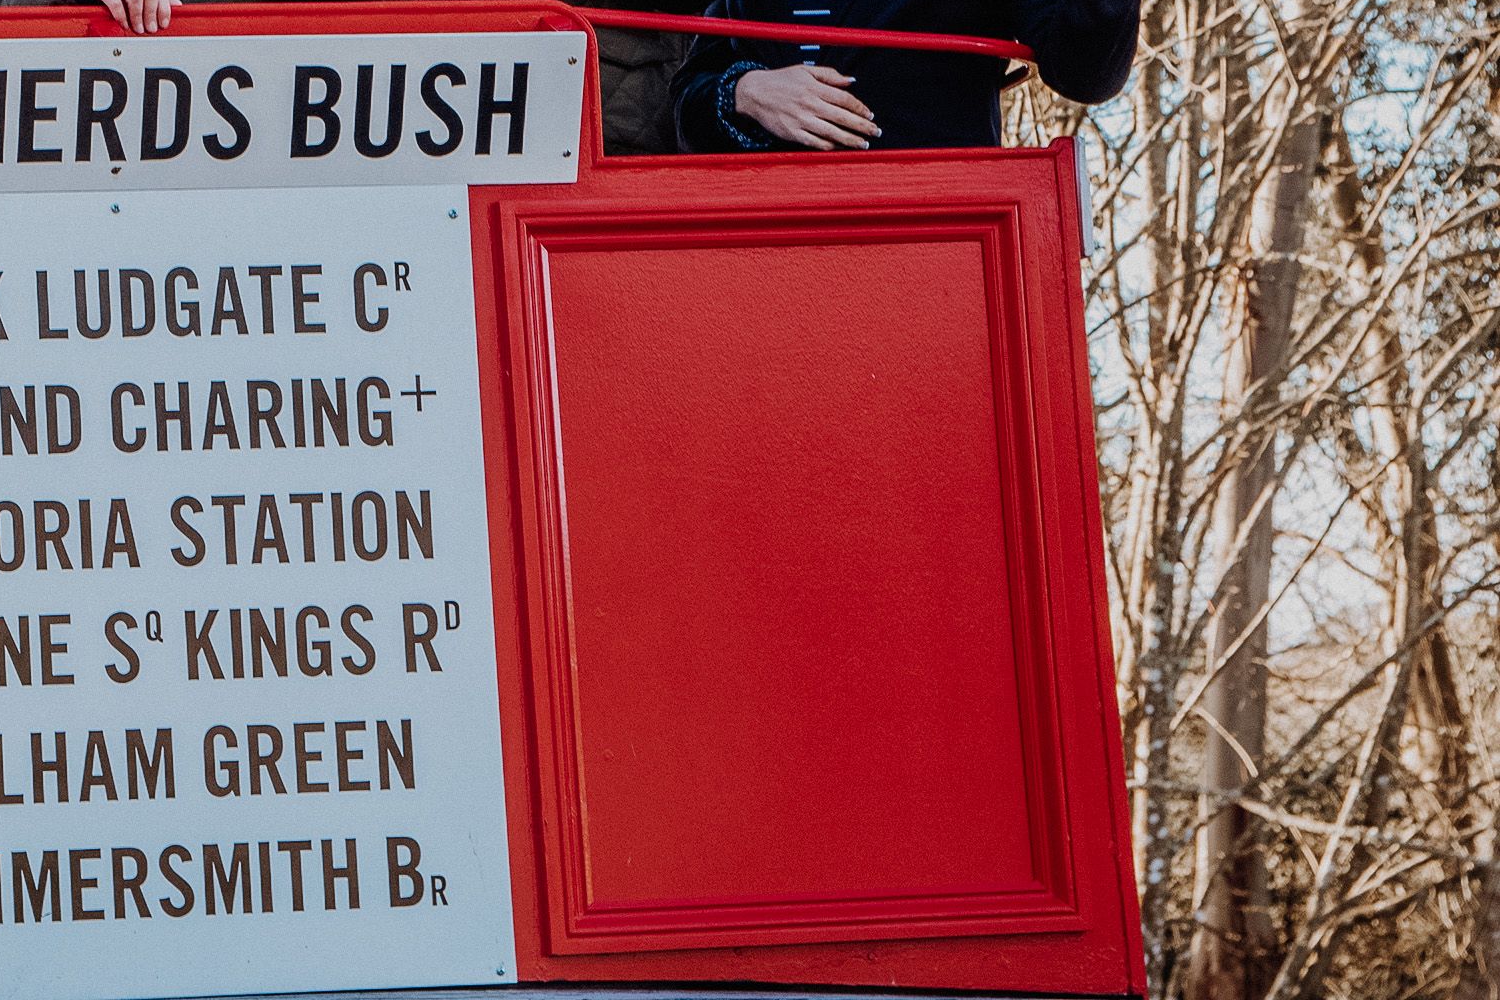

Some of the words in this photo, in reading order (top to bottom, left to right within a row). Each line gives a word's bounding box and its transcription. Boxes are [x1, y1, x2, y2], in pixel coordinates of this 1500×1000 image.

[289, 62, 529, 159] BUSH
[35, 264, 327, 340] LUDGATE
[170, 489, 434, 567] STATION
[185, 604, 376, 681] KINGS
[203, 718, 416, 798] GREEN
